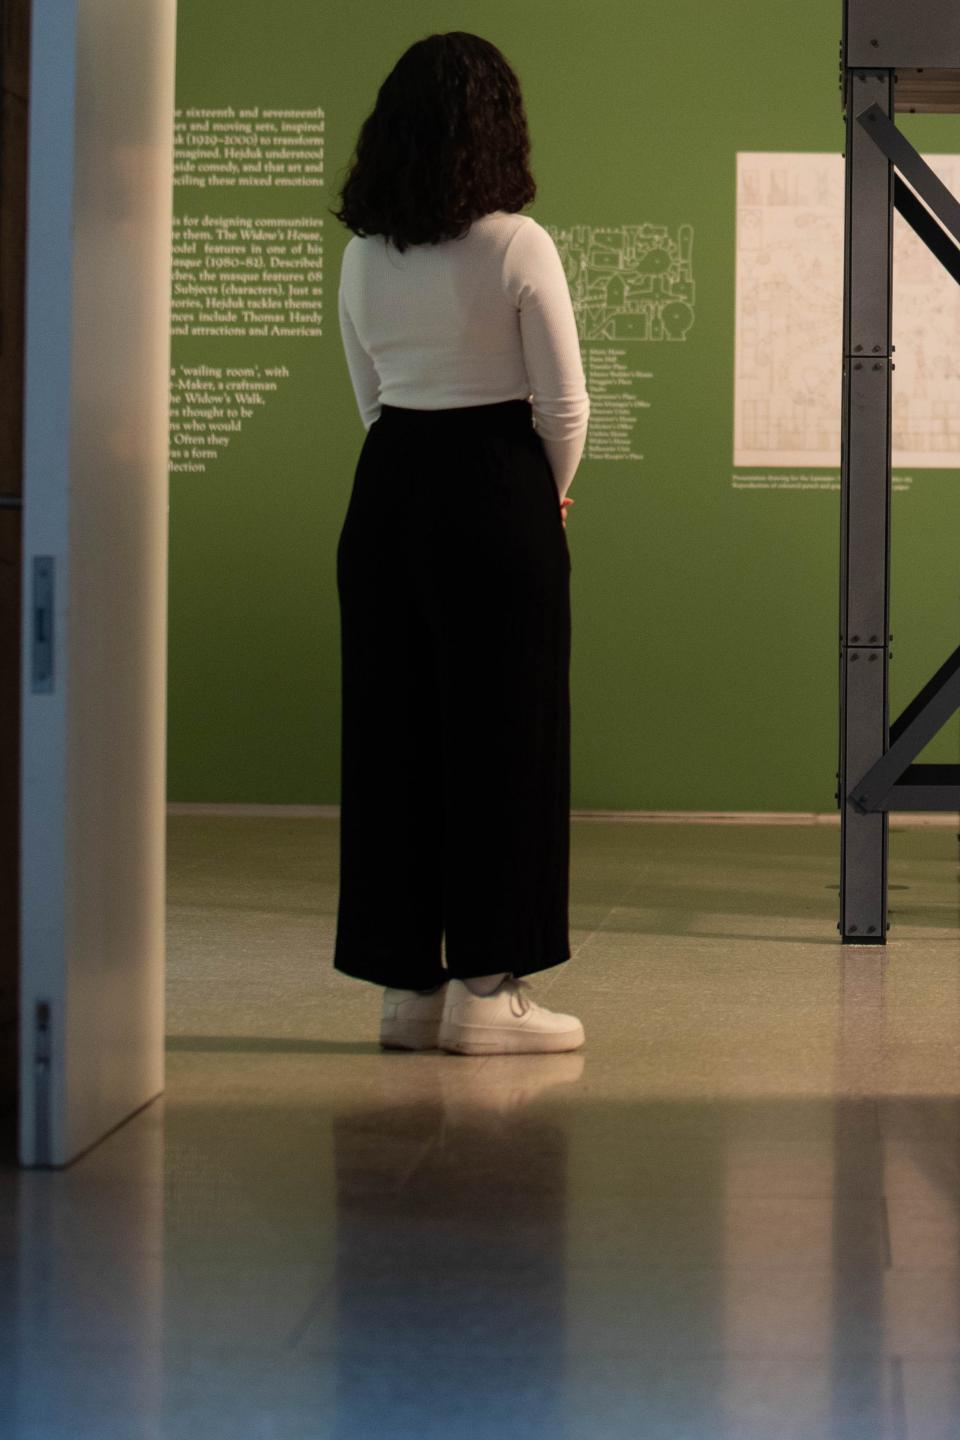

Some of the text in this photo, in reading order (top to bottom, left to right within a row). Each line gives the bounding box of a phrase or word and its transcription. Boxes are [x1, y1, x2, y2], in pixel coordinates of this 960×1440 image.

[186, 106, 235, 118] sixteenth
[239, 106, 258, 118] and
[262, 106, 325, 118] seventeenth
[190, 120, 209, 132] and
[213, 120, 252, 134] moving
[281, 120, 325, 134] inspired
[260, 133, 271, 145] to
[273, 133, 324, 145] transform
[224, 147, 262, 161] Hejduk
[265, 147, 323, 158] understood
[243, 160, 261, 172] and
[264, 160, 284, 172] that
[288, 160, 301, 172] art
[305, 160, 323, 172] and
[208, 174, 235, 186] these
[239, 174, 272, 186] mixed
[275, 174, 324, 186] emotions
[183, 215, 199, 227] for
[201, 215, 253, 230] designing
[255, 215, 323, 227] communities
[204, 242, 246, 254] features
[251, 242, 262, 254] in
[266, 245, 286, 254] one
[291, 242, 302, 254] of
[307, 242, 323, 254] his
[270, 255, 323, 267] Described
[199, 269, 216, 281] the
[219, 272, 260, 284] masque
[262, 269, 304, 281] features
[206, 296, 245, 311] Hejduk
[285, 296, 322, 308] themes
[199, 310, 238, 322] include
[242, 310, 284, 322] Thomas
[289, 310, 322, 324] Hardy
[192, 323, 246, 335] attractions
[249, 323, 268, 335] and
[271, 323, 322, 335] American
[264, 365, 289, 376] with
[226, 378, 277, 390] craftsman
[183, 405, 223, 420] thought
[227, 405, 238, 417] to
[241, 405, 253, 417] be
[183, 419, 206, 430] who
[209, 419, 241, 430] would
[174, 432, 230, 447] Often they
[192, 446, 217, 458] form
